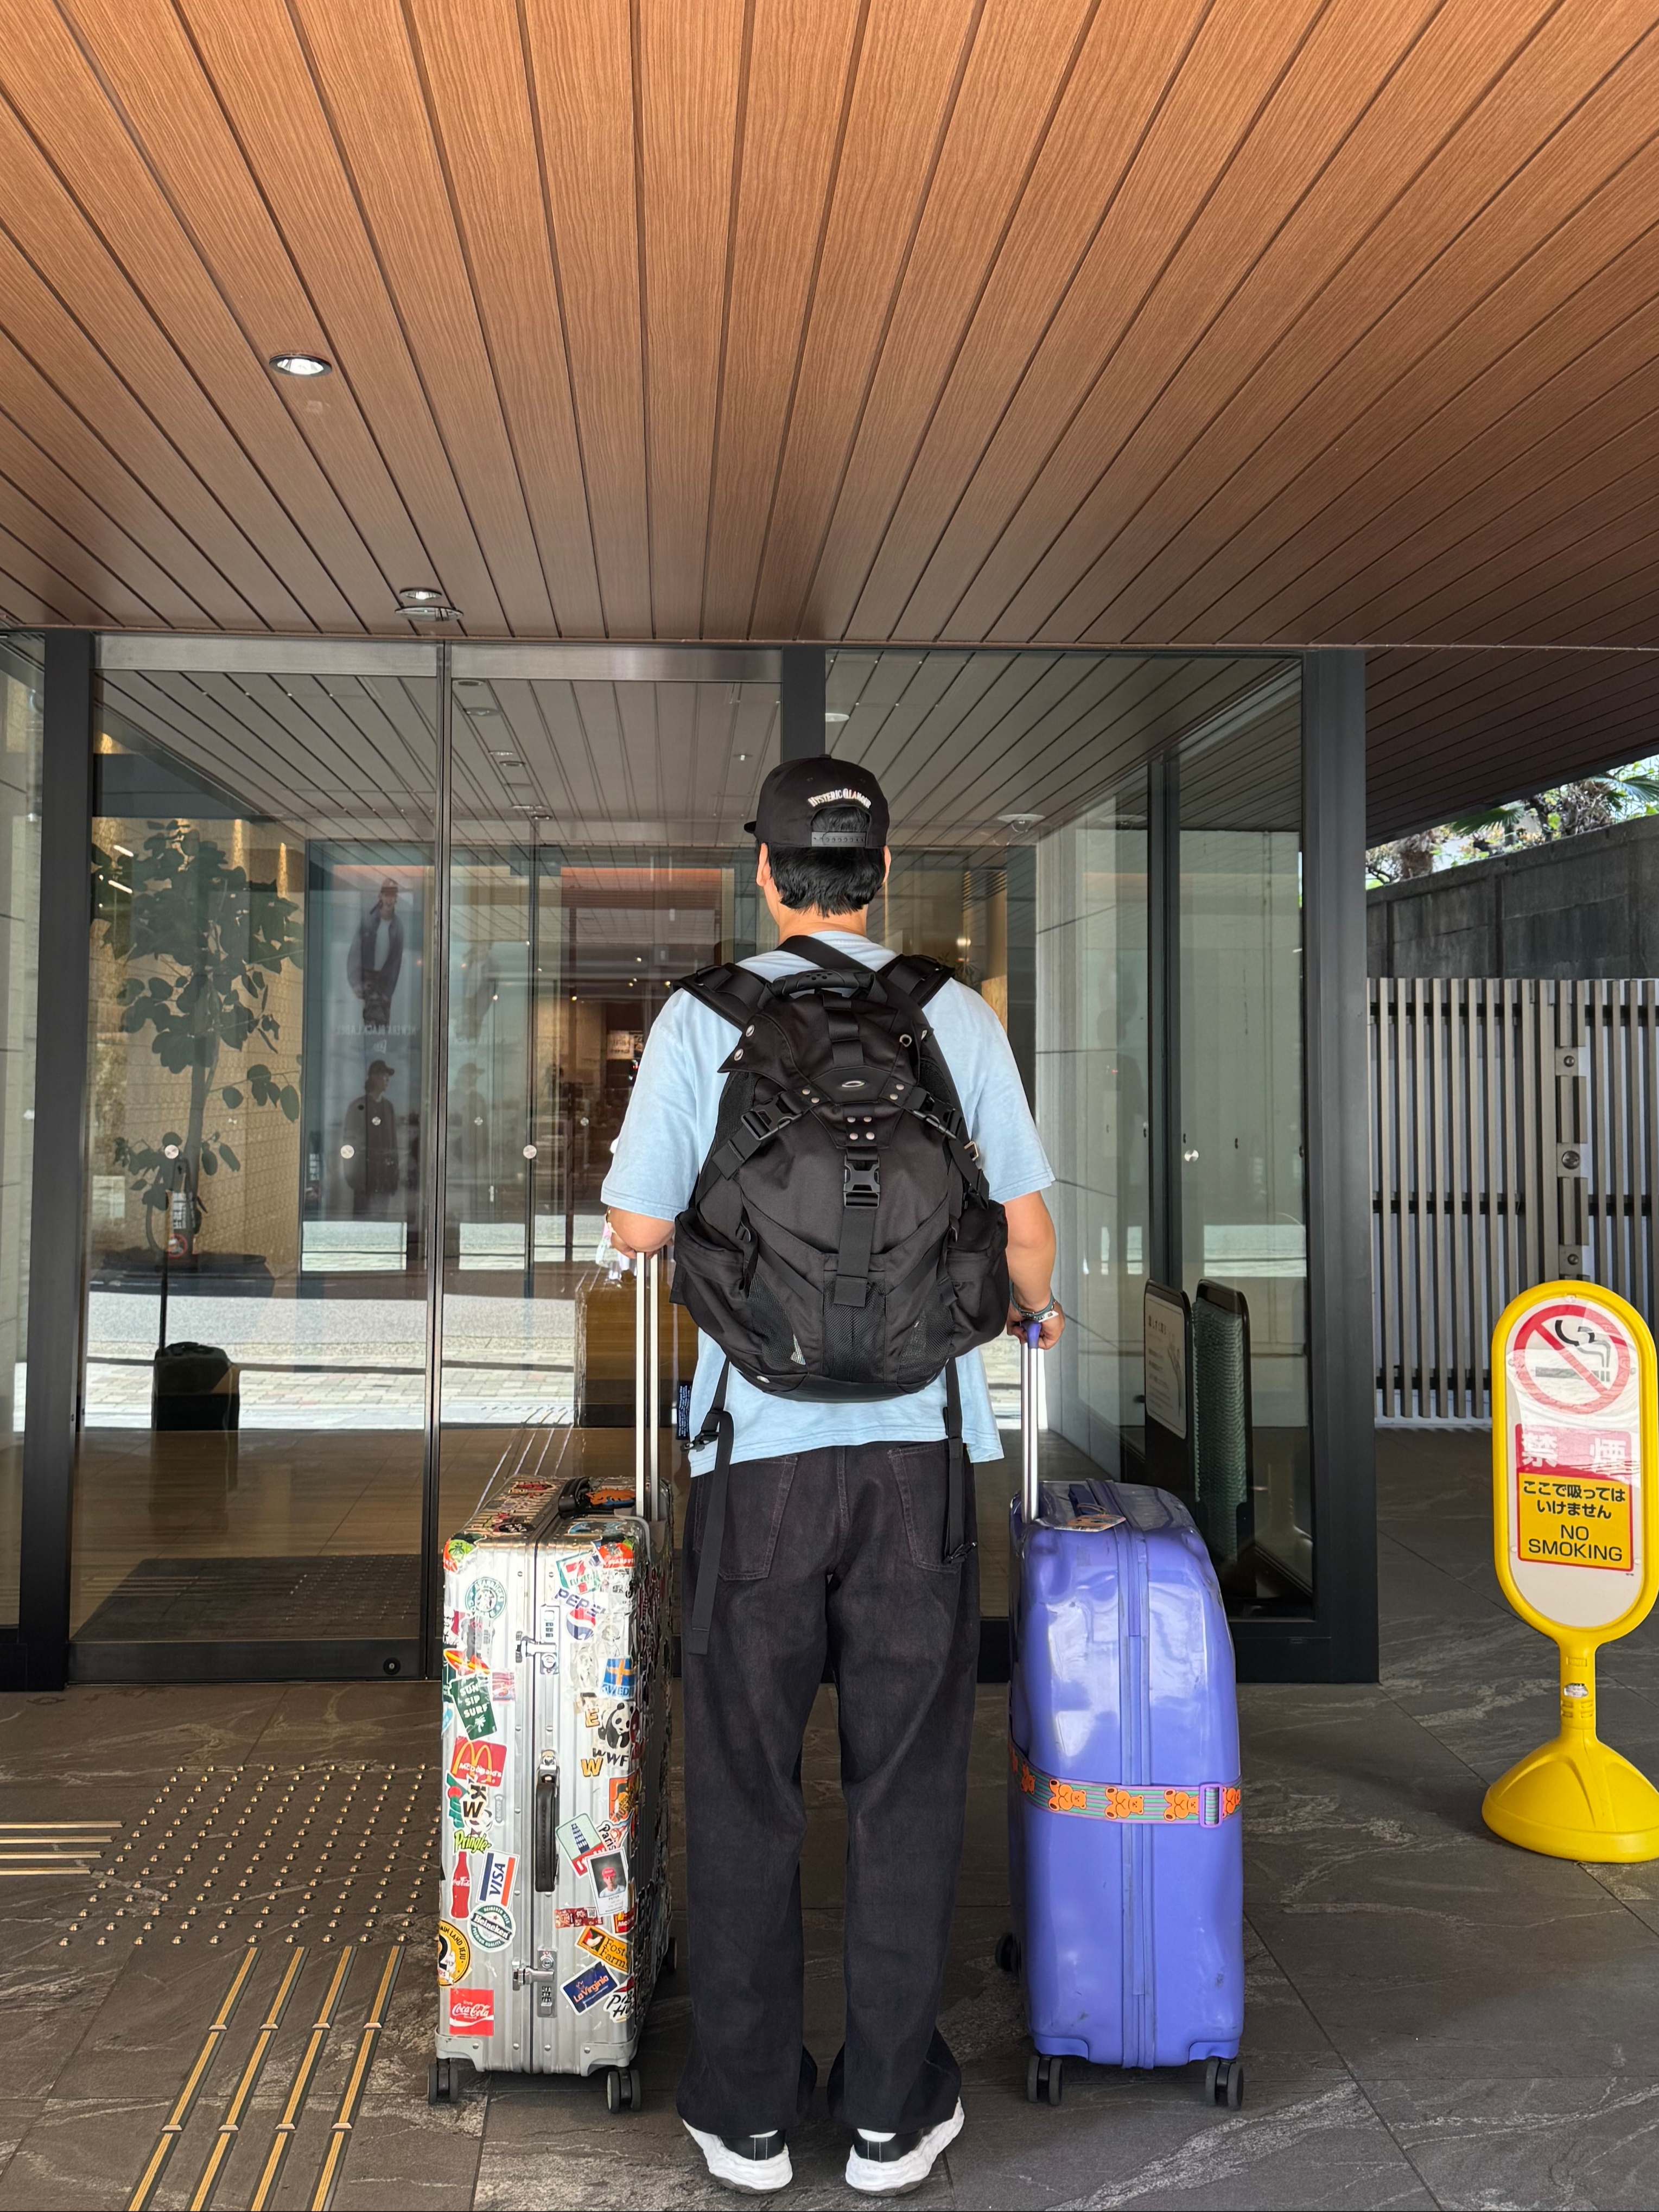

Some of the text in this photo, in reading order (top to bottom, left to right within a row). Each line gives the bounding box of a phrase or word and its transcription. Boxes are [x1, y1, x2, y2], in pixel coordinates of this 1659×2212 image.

[1523, 1480, 1626, 1502] ここで吸っては
[1537, 1500, 1612, 1520] いけません
[1561, 1524, 1590, 1541] NO
[1528, 1539, 1623, 1562] SMOKING
[460, 1684, 479, 1696] SUN
[463, 1703, 488, 1718] SURF
[465, 1695, 481, 1706] SIP
[592, 1747, 630, 1767] WWF
[463, 1801, 484, 1818] W
[599, 1824, 617, 1851] Paris
[490, 1863, 506, 1896] VISA
[474, 1915, 509, 1939] Heineken
[449, 1930, 463, 1946] LAND
